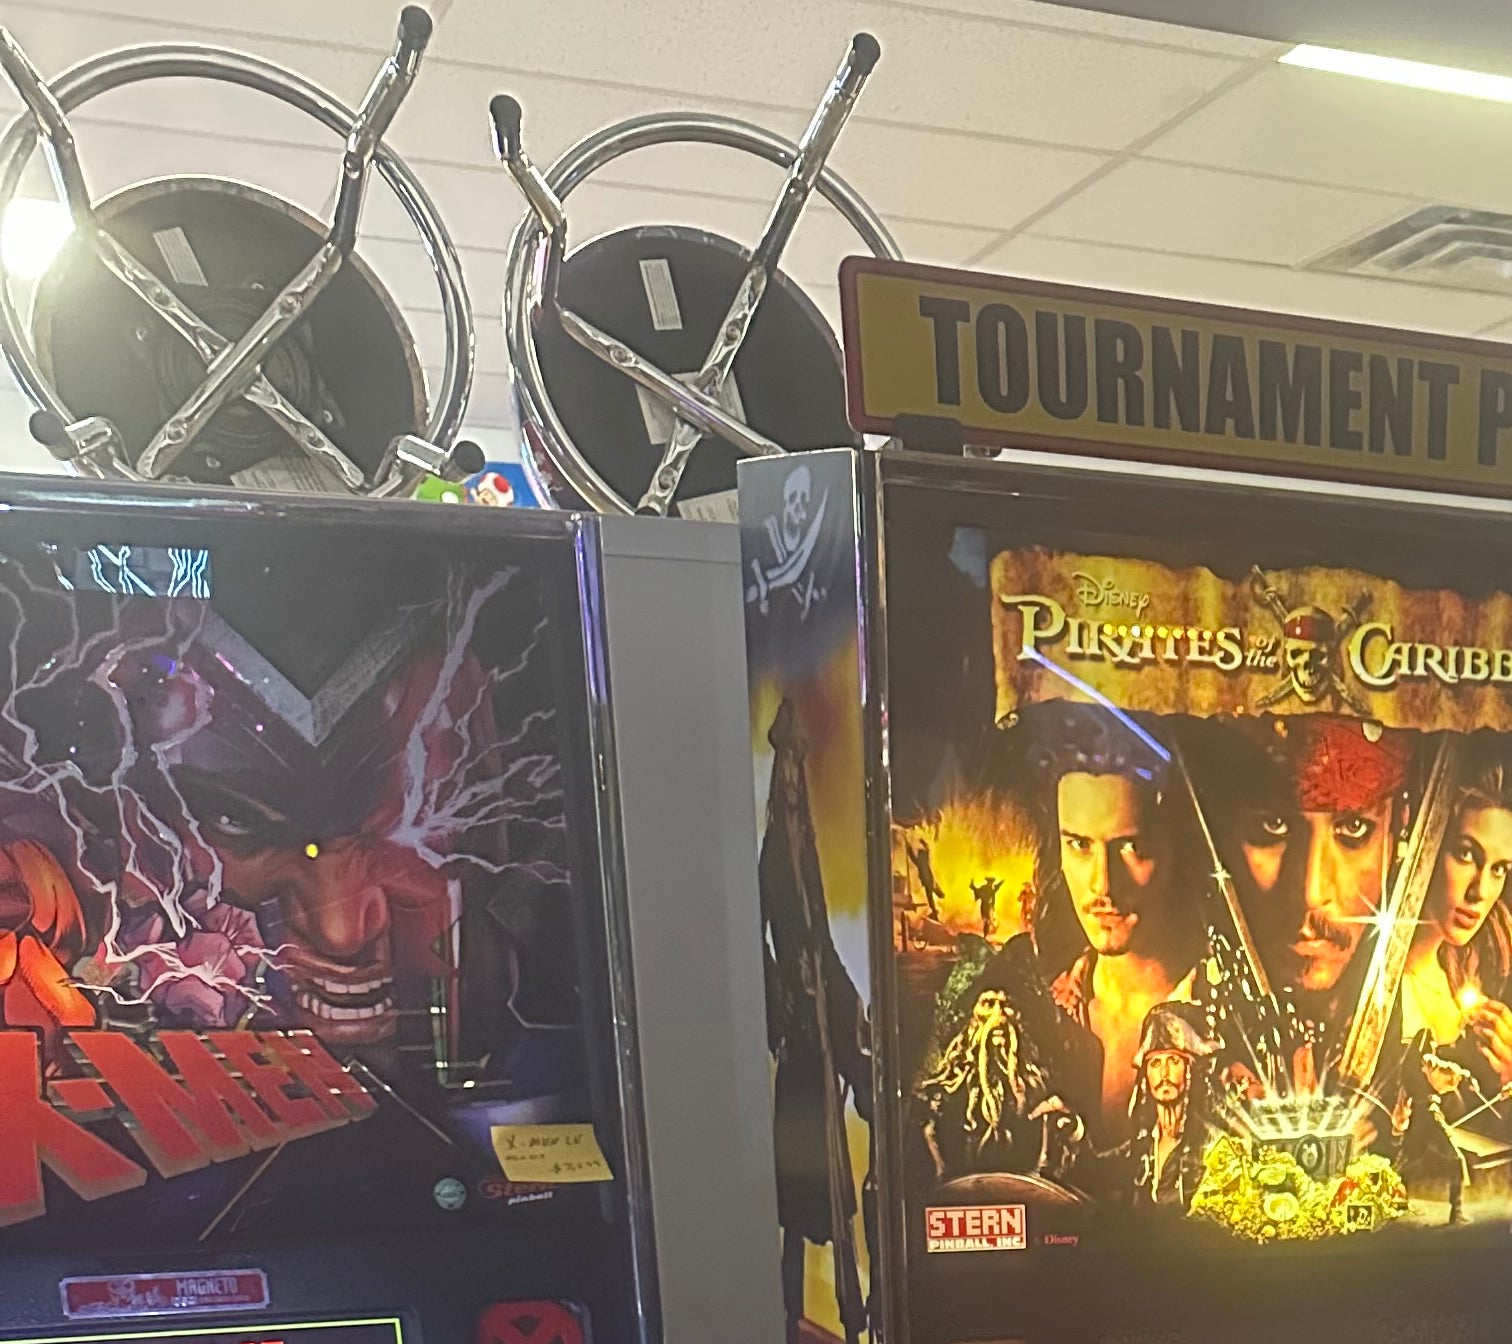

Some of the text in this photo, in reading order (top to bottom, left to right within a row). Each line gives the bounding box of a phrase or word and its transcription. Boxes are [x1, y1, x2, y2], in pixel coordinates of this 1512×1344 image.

[920, 294, 1461, 461] TOURNAMENT
[1001, 594, 1243, 671] PIRATES
[1257, 634, 1276, 652] of
[1244, 648, 1278, 668] the
[929, 1208, 1023, 1238] STERN
